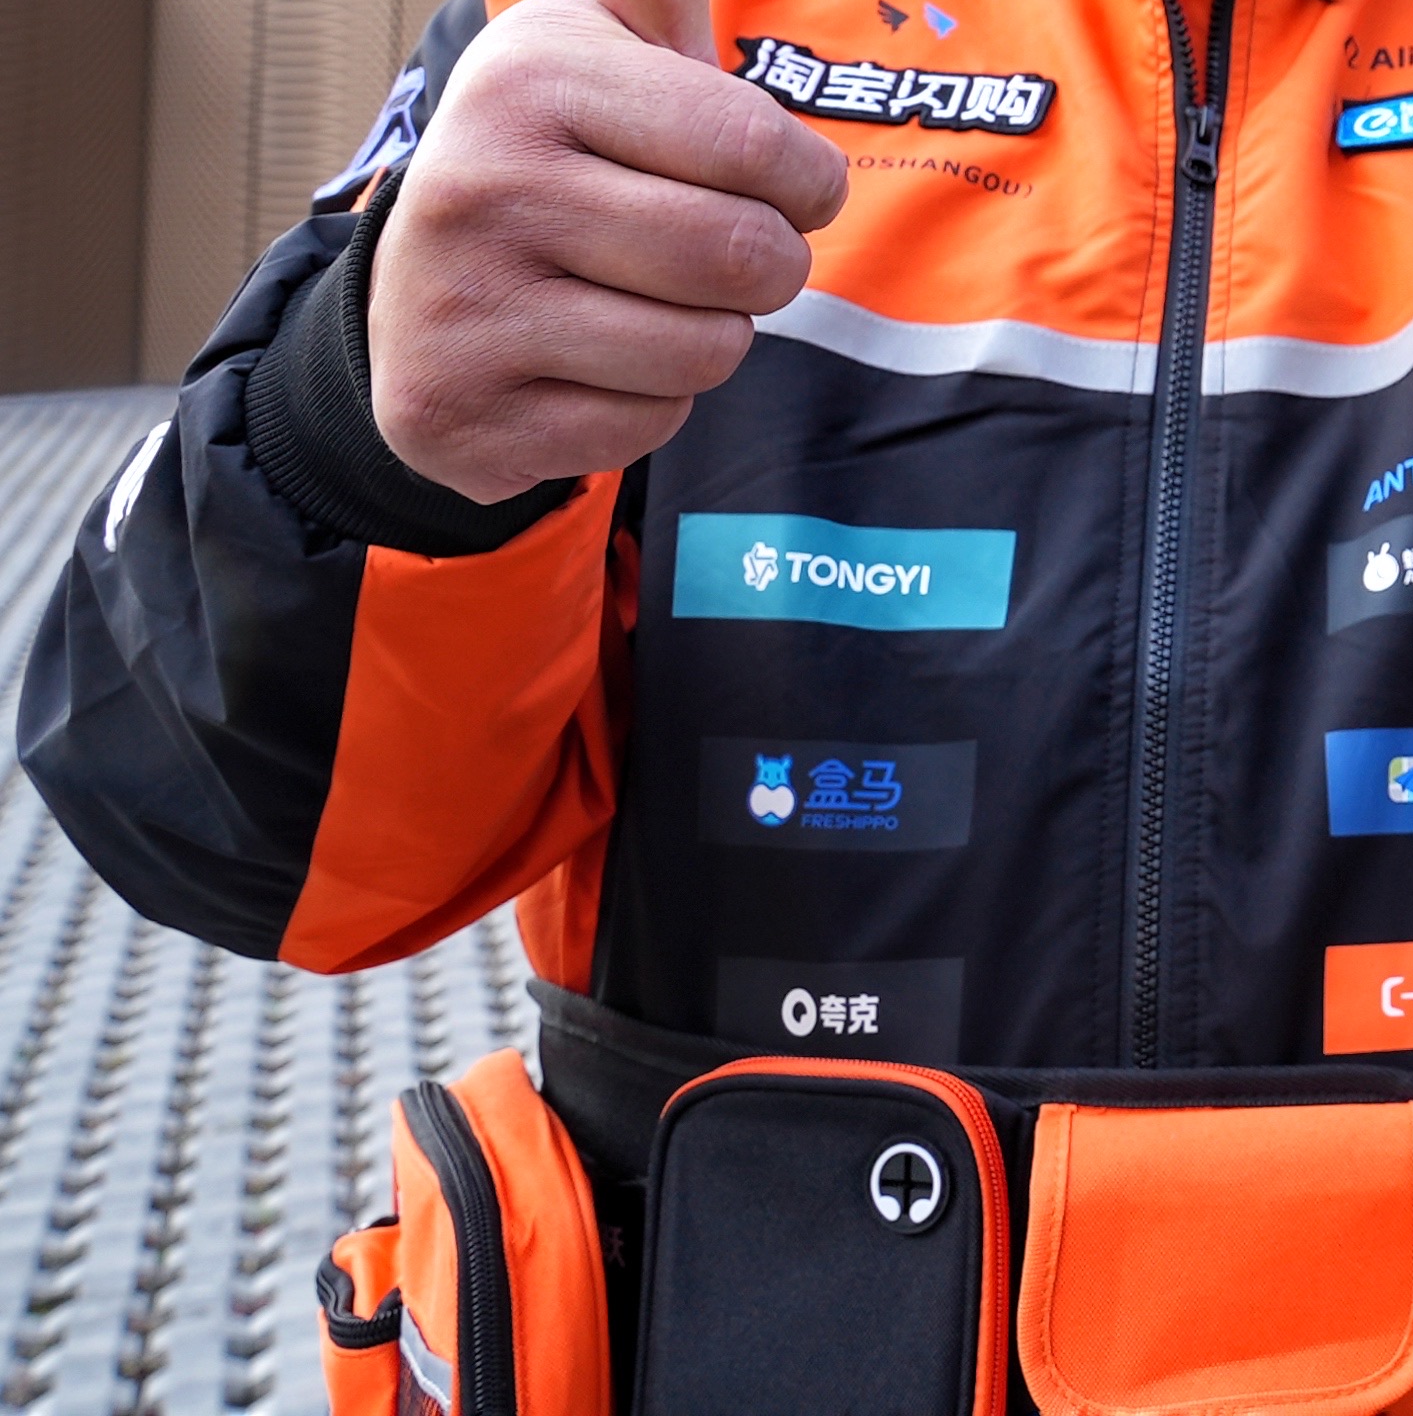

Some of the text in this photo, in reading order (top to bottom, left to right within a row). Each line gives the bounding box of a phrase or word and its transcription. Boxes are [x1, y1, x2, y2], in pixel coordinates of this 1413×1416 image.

[745, 37, 1046, 127] 淘宝闪购
[845, 155, 1034, 198] OSHANGOU)
[785, 551, 931, 596] TONGYI
[804, 757, 901, 812] 盒马
[802, 813, 899, 831] FRESHIPPO
[819, 994, 879, 1036] 夸克
